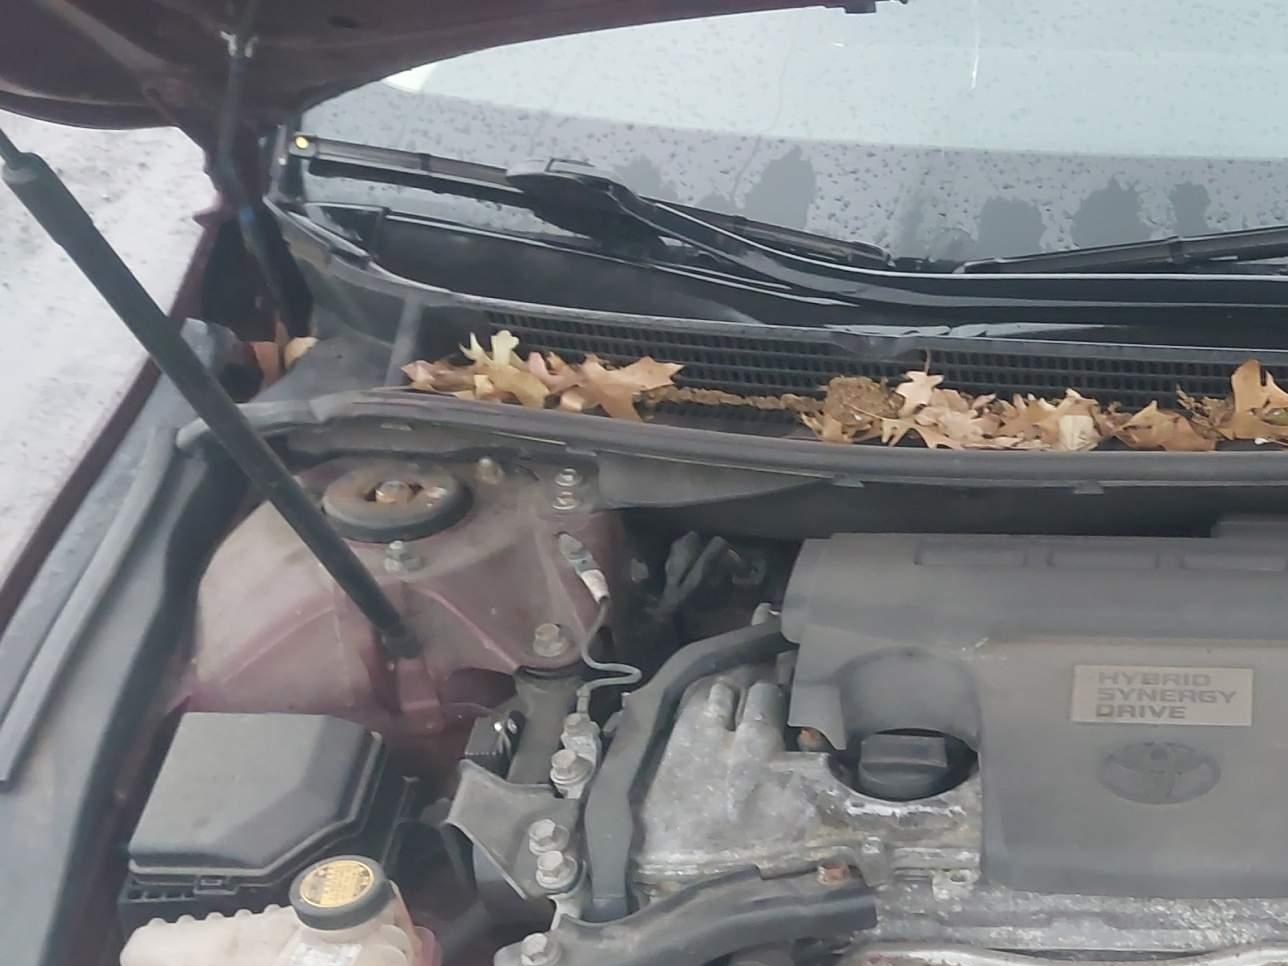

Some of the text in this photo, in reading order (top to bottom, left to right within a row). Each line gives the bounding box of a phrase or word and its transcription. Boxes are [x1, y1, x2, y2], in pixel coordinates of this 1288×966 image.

[1098, 672, 1212, 687] HYBRID
[1097, 688, 1237, 704] SYNERGY
[1095, 704, 1187, 719] DRIVE
